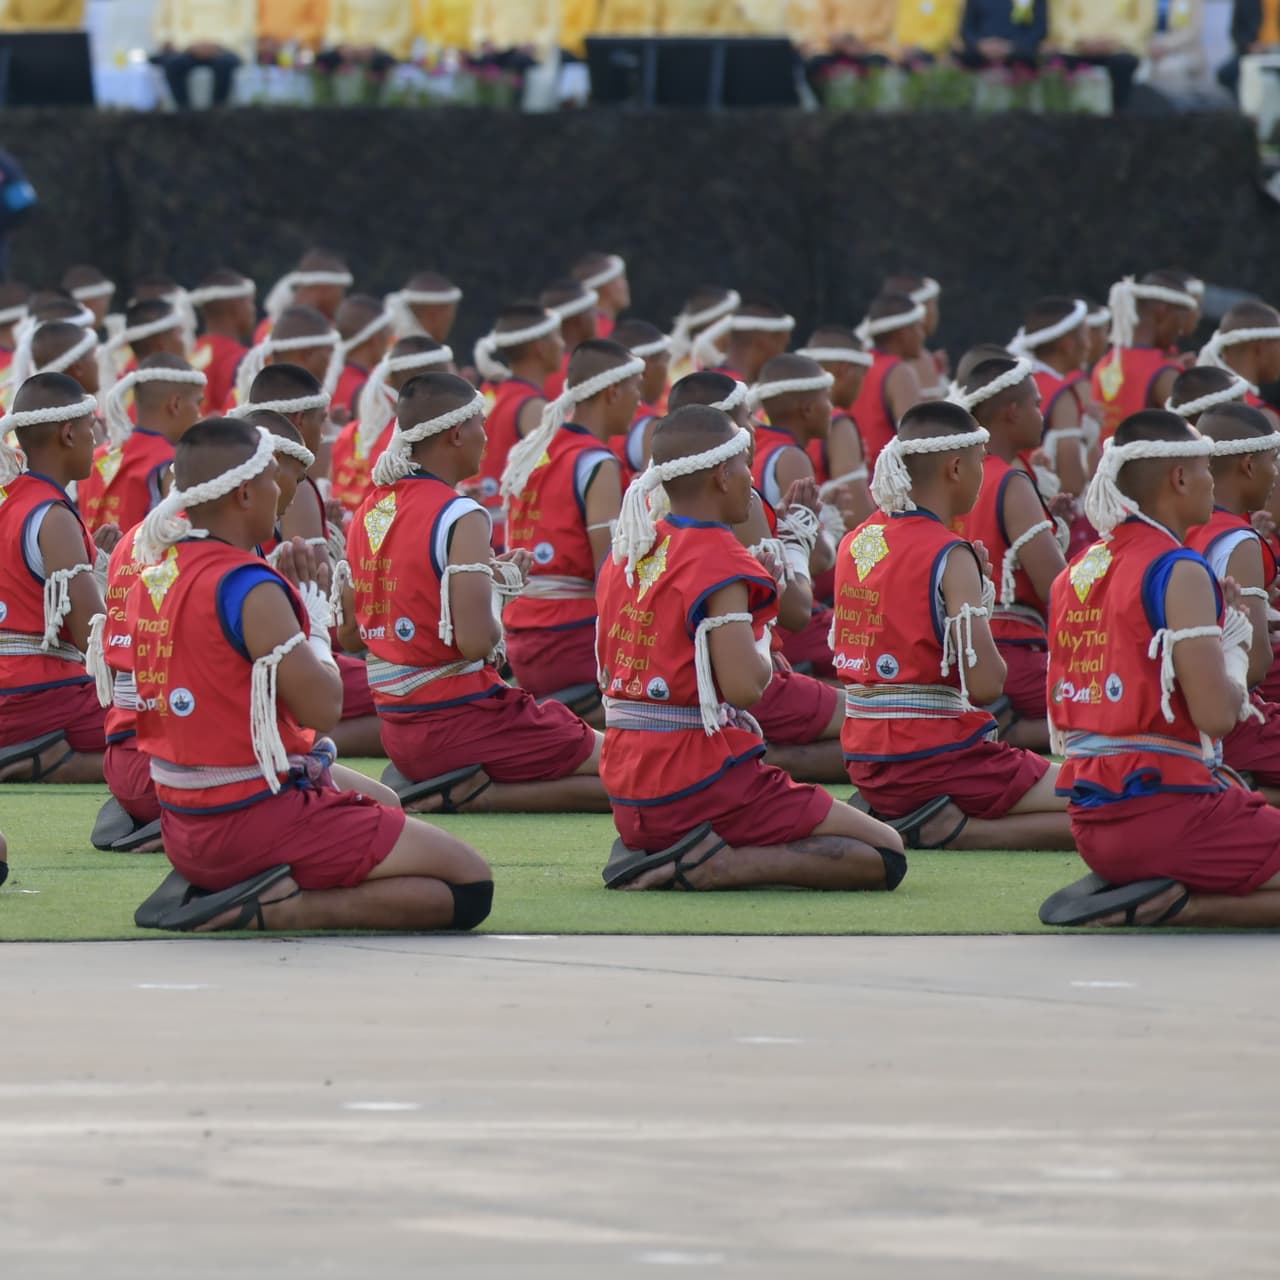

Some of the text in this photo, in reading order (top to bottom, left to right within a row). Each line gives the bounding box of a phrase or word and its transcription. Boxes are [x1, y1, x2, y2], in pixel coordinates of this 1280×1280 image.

[840, 583, 880, 607] Amazing
[835, 605, 862, 627] Muay
[608, 623, 635, 642] Mua
